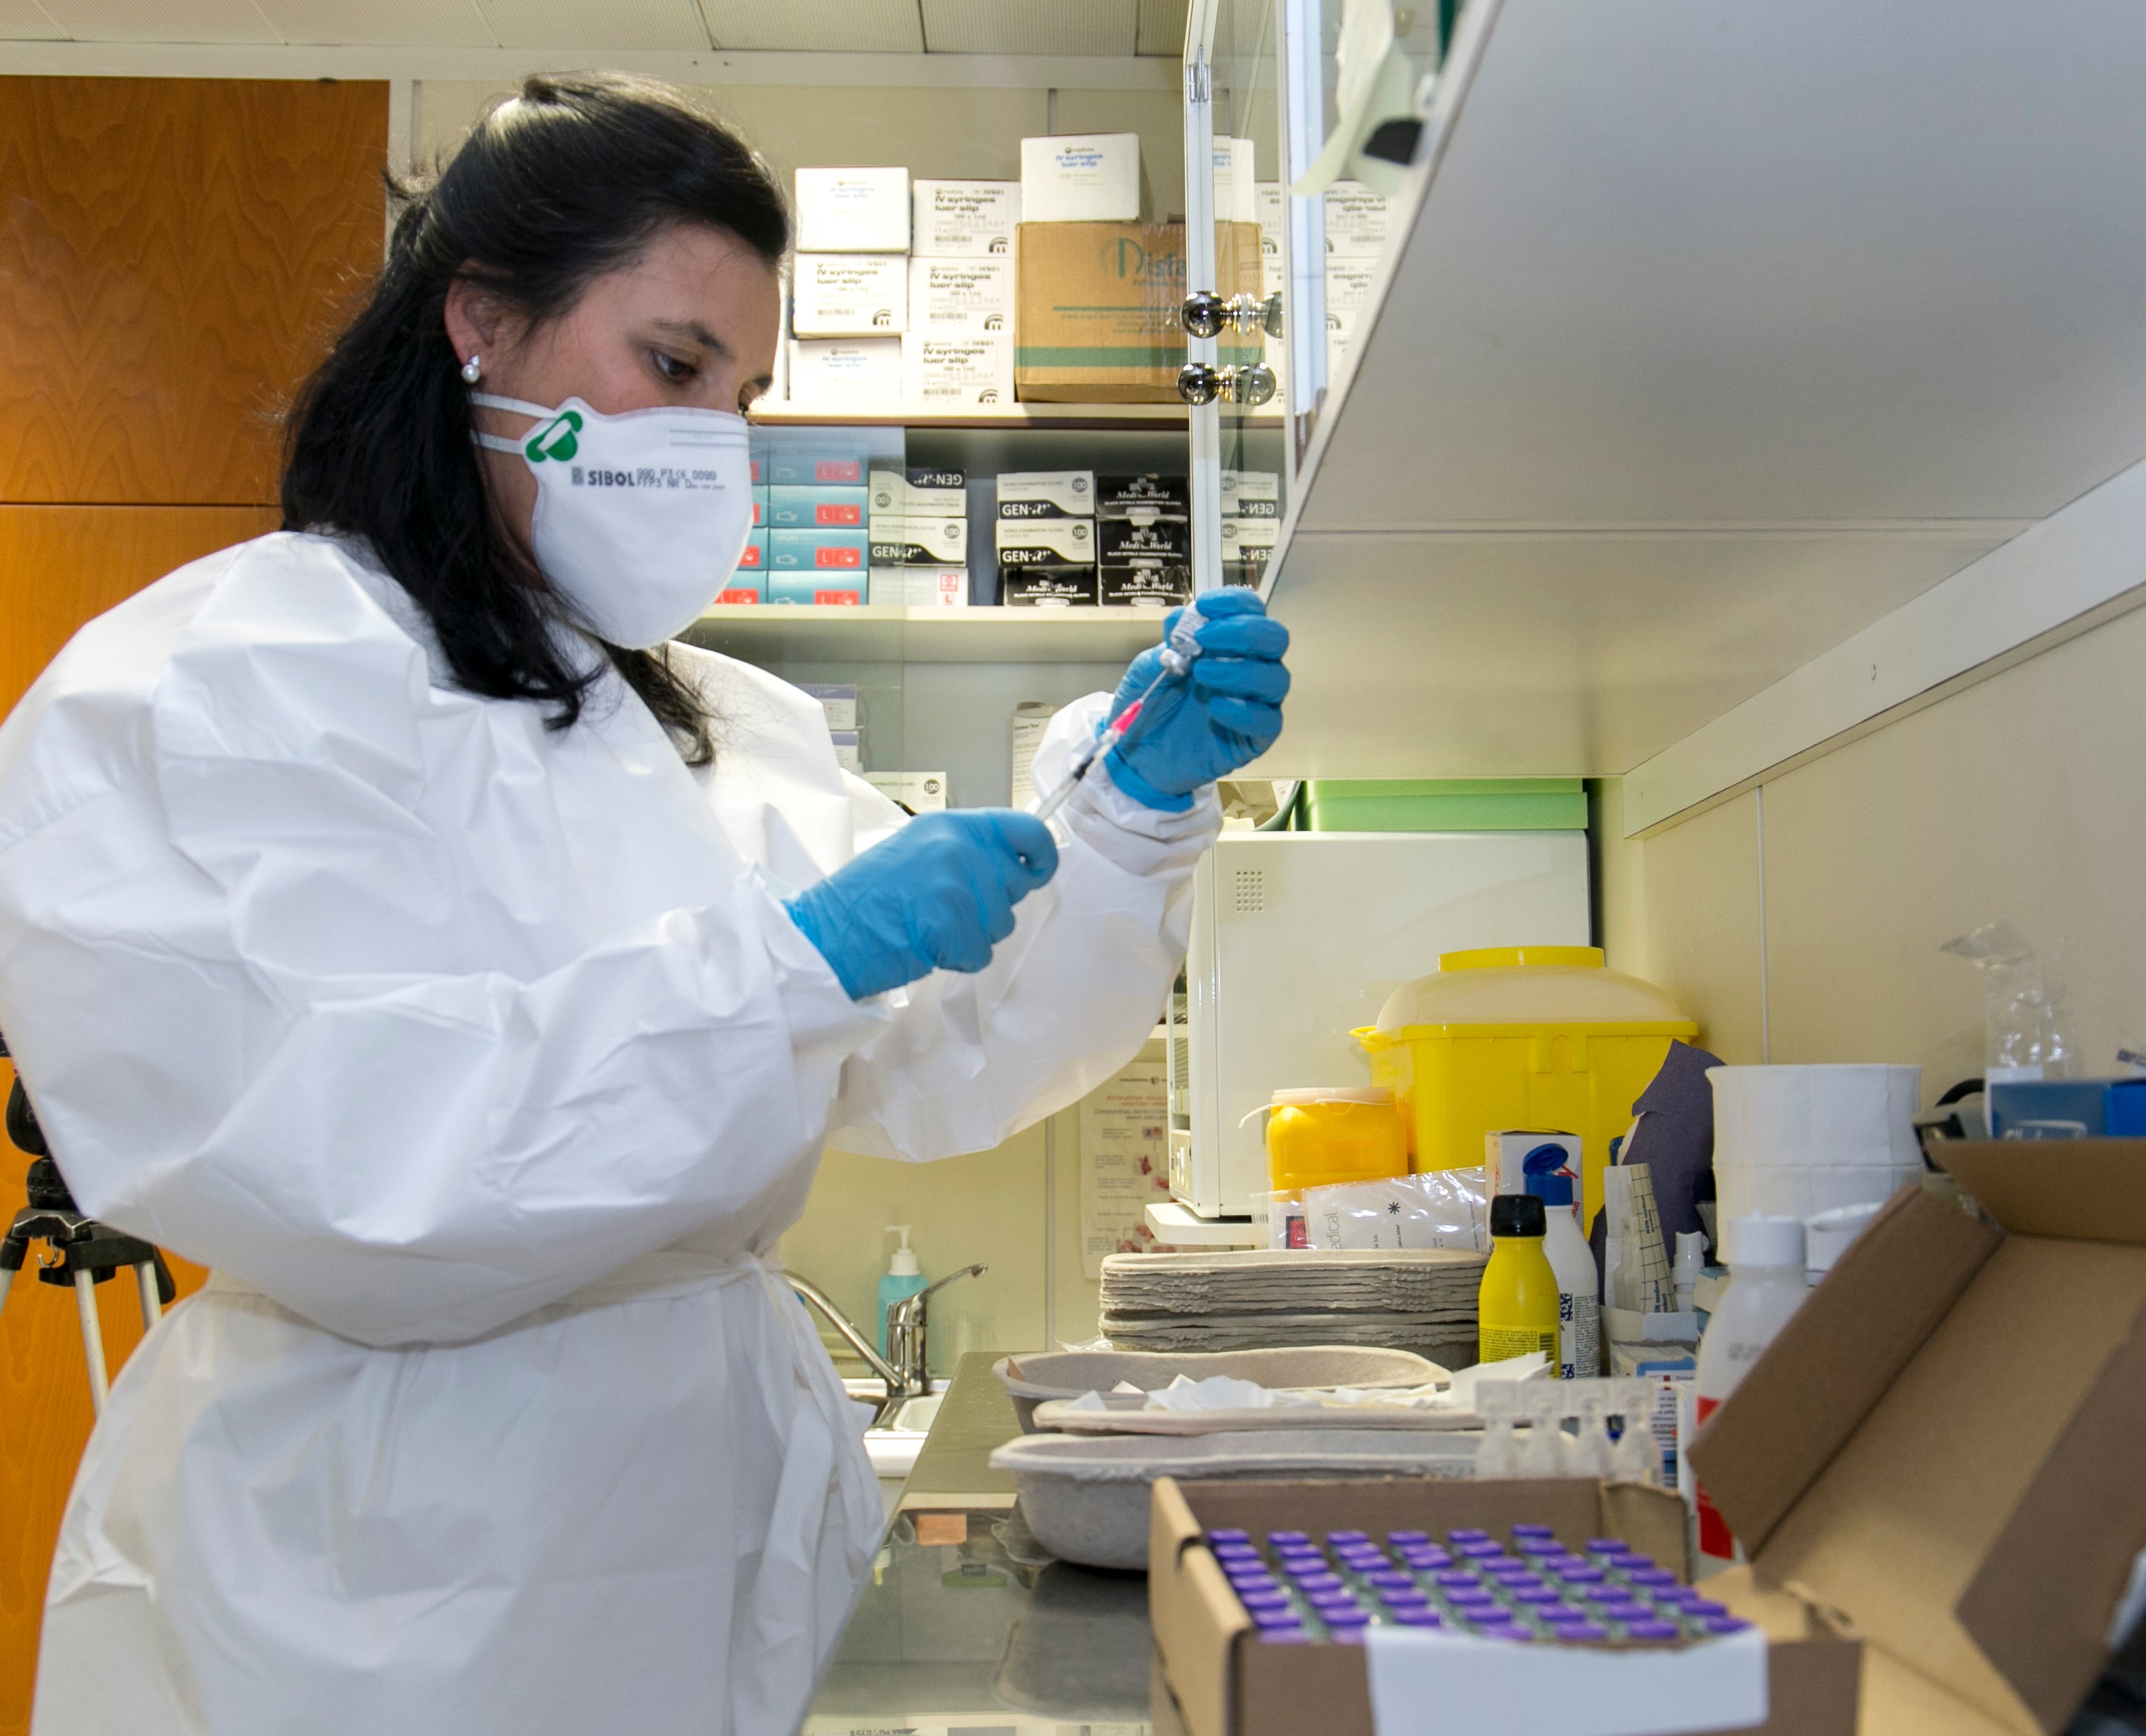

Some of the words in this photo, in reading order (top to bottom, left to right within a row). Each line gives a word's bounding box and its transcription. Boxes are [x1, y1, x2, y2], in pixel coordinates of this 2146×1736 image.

[942, 272, 991, 280] syringes
[587, 470, 635, 486] SIBOL
[822, 509, 828, 519] L
[1119, 541, 1140, 549] Medi
[1150, 541, 1172, 550] World
[822, 553, 828, 562] L
[1151, 582, 1174, 591] World
[945, 594, 952, 603] L
